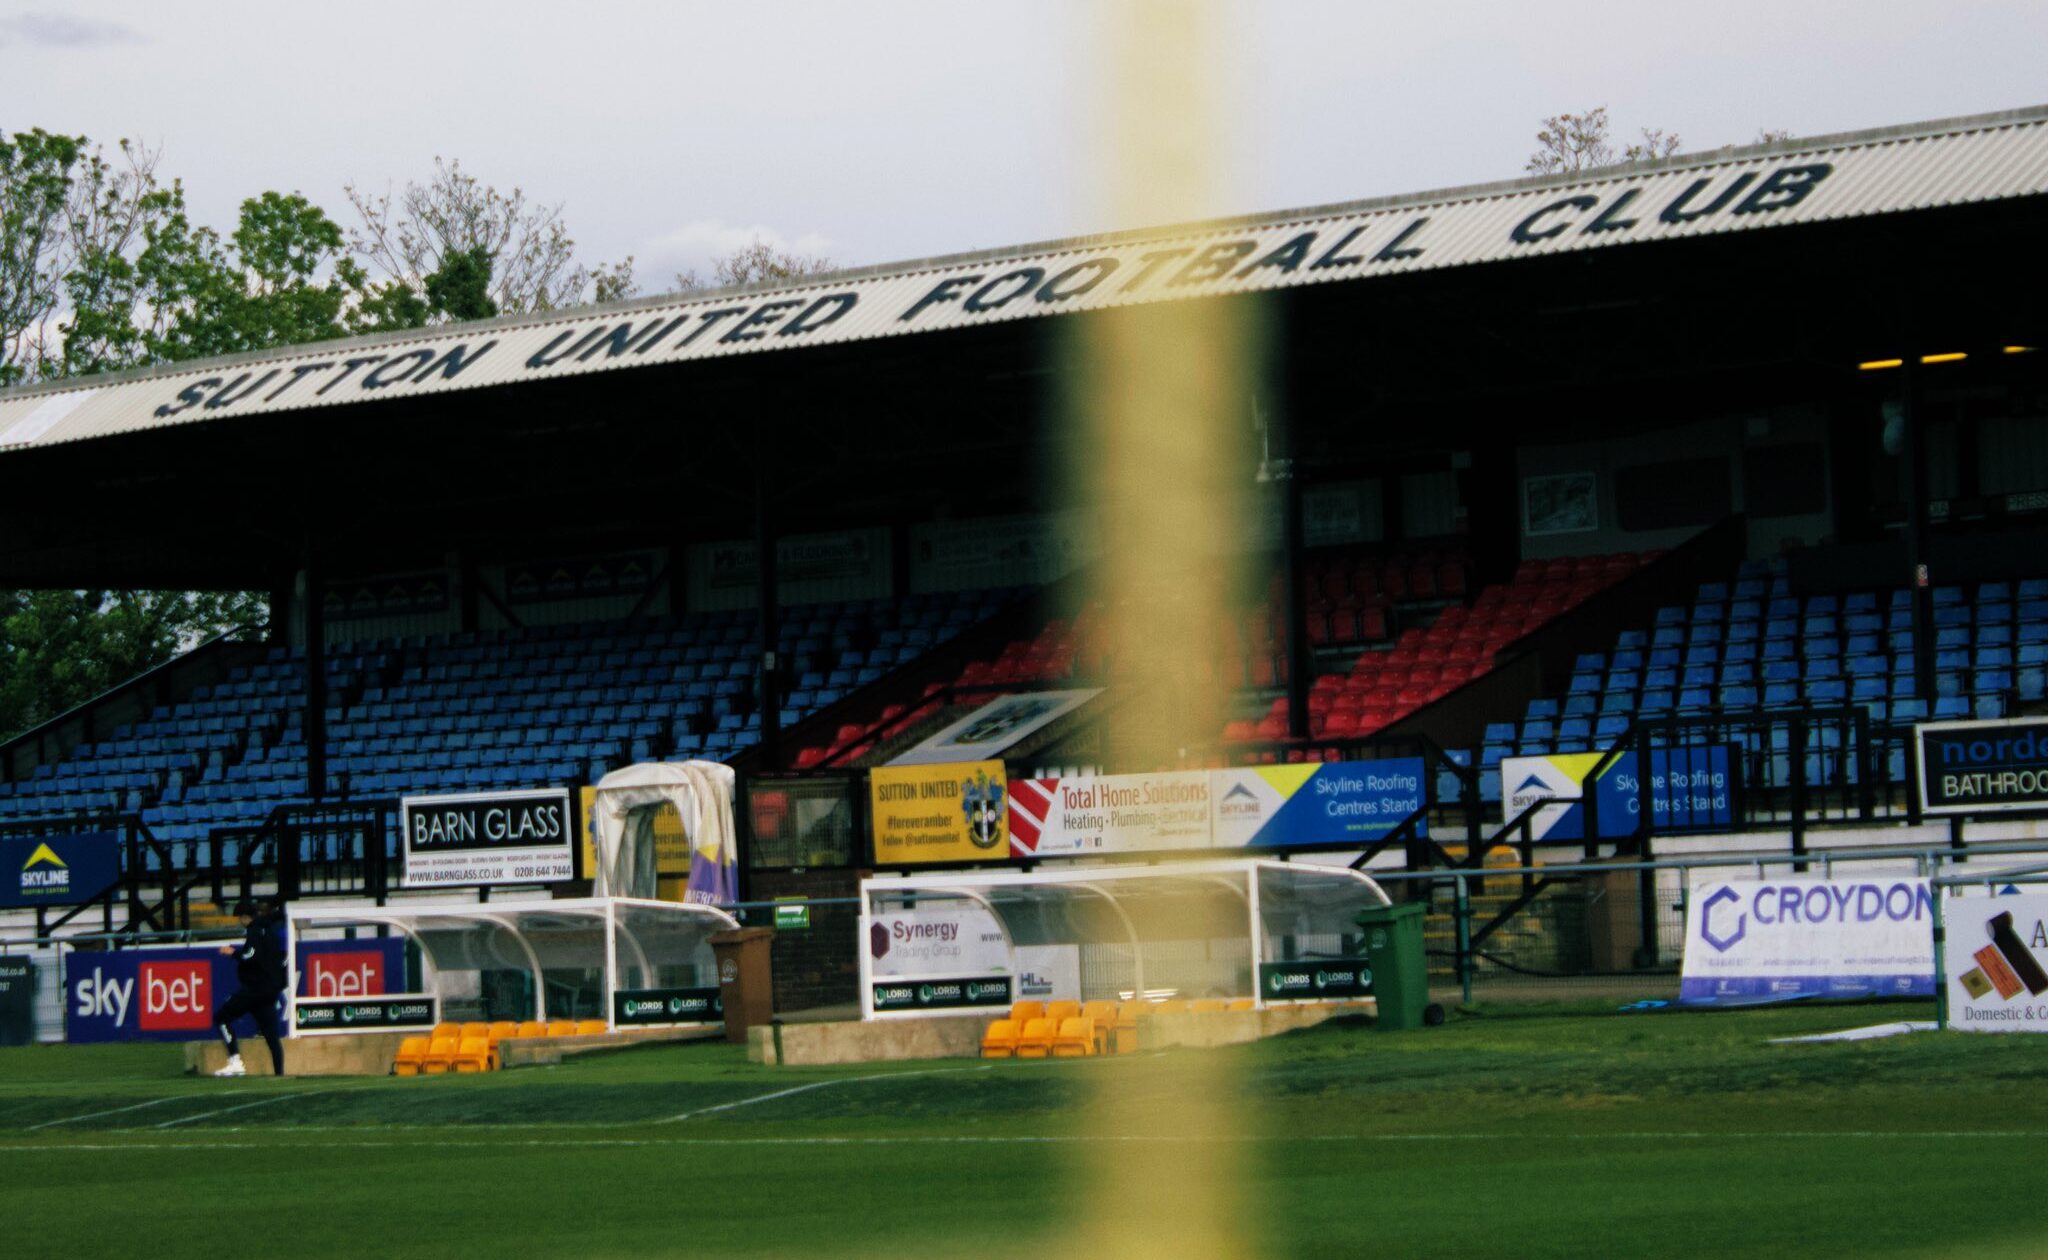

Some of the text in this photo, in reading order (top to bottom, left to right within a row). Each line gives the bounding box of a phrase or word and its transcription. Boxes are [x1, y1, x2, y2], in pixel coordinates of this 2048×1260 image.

[154, 161, 1832, 418] SUTTON UNITED FOOTBALL CLUB
[879, 781, 958, 802] SUTTON UNITED
[1315, 774, 1417, 796] Skyline Roofing
[1616, 774, 1665, 793] Skyne
[1062, 778, 1208, 810] Total Home Solutions
[1220, 802, 1261, 814] SKYLINE
[1328, 797, 1418, 816] Centres Stand
[414, 805, 560, 844] BARN GLASS
[1063, 813, 1104, 832] Heating
[1111, 810, 1156, 829] Plumbing
[21, 869, 70, 887] SKYLINE
[408, 864, 571, 883] WWW.BARNGLASS.CO.UK 0208 644 7444
[1753, 884, 1933, 924] CROYDON
[893, 920, 959, 942] Synergy
[895, 943, 961, 959] Trading Group
[1283, 972, 1354, 984] LORDS LORDS
[77, 966, 205, 1029] sky bet
[886, 983, 1007, 999] LORDS LORDS LORDS
[308, 1004, 428, 1019] LORDS LORDS LORDS
[637, 998, 708, 1010] LORDS LORDS
[1964, 1006, 2022, 1021] Domestic
[2025, 1005, 2035, 1020] &
